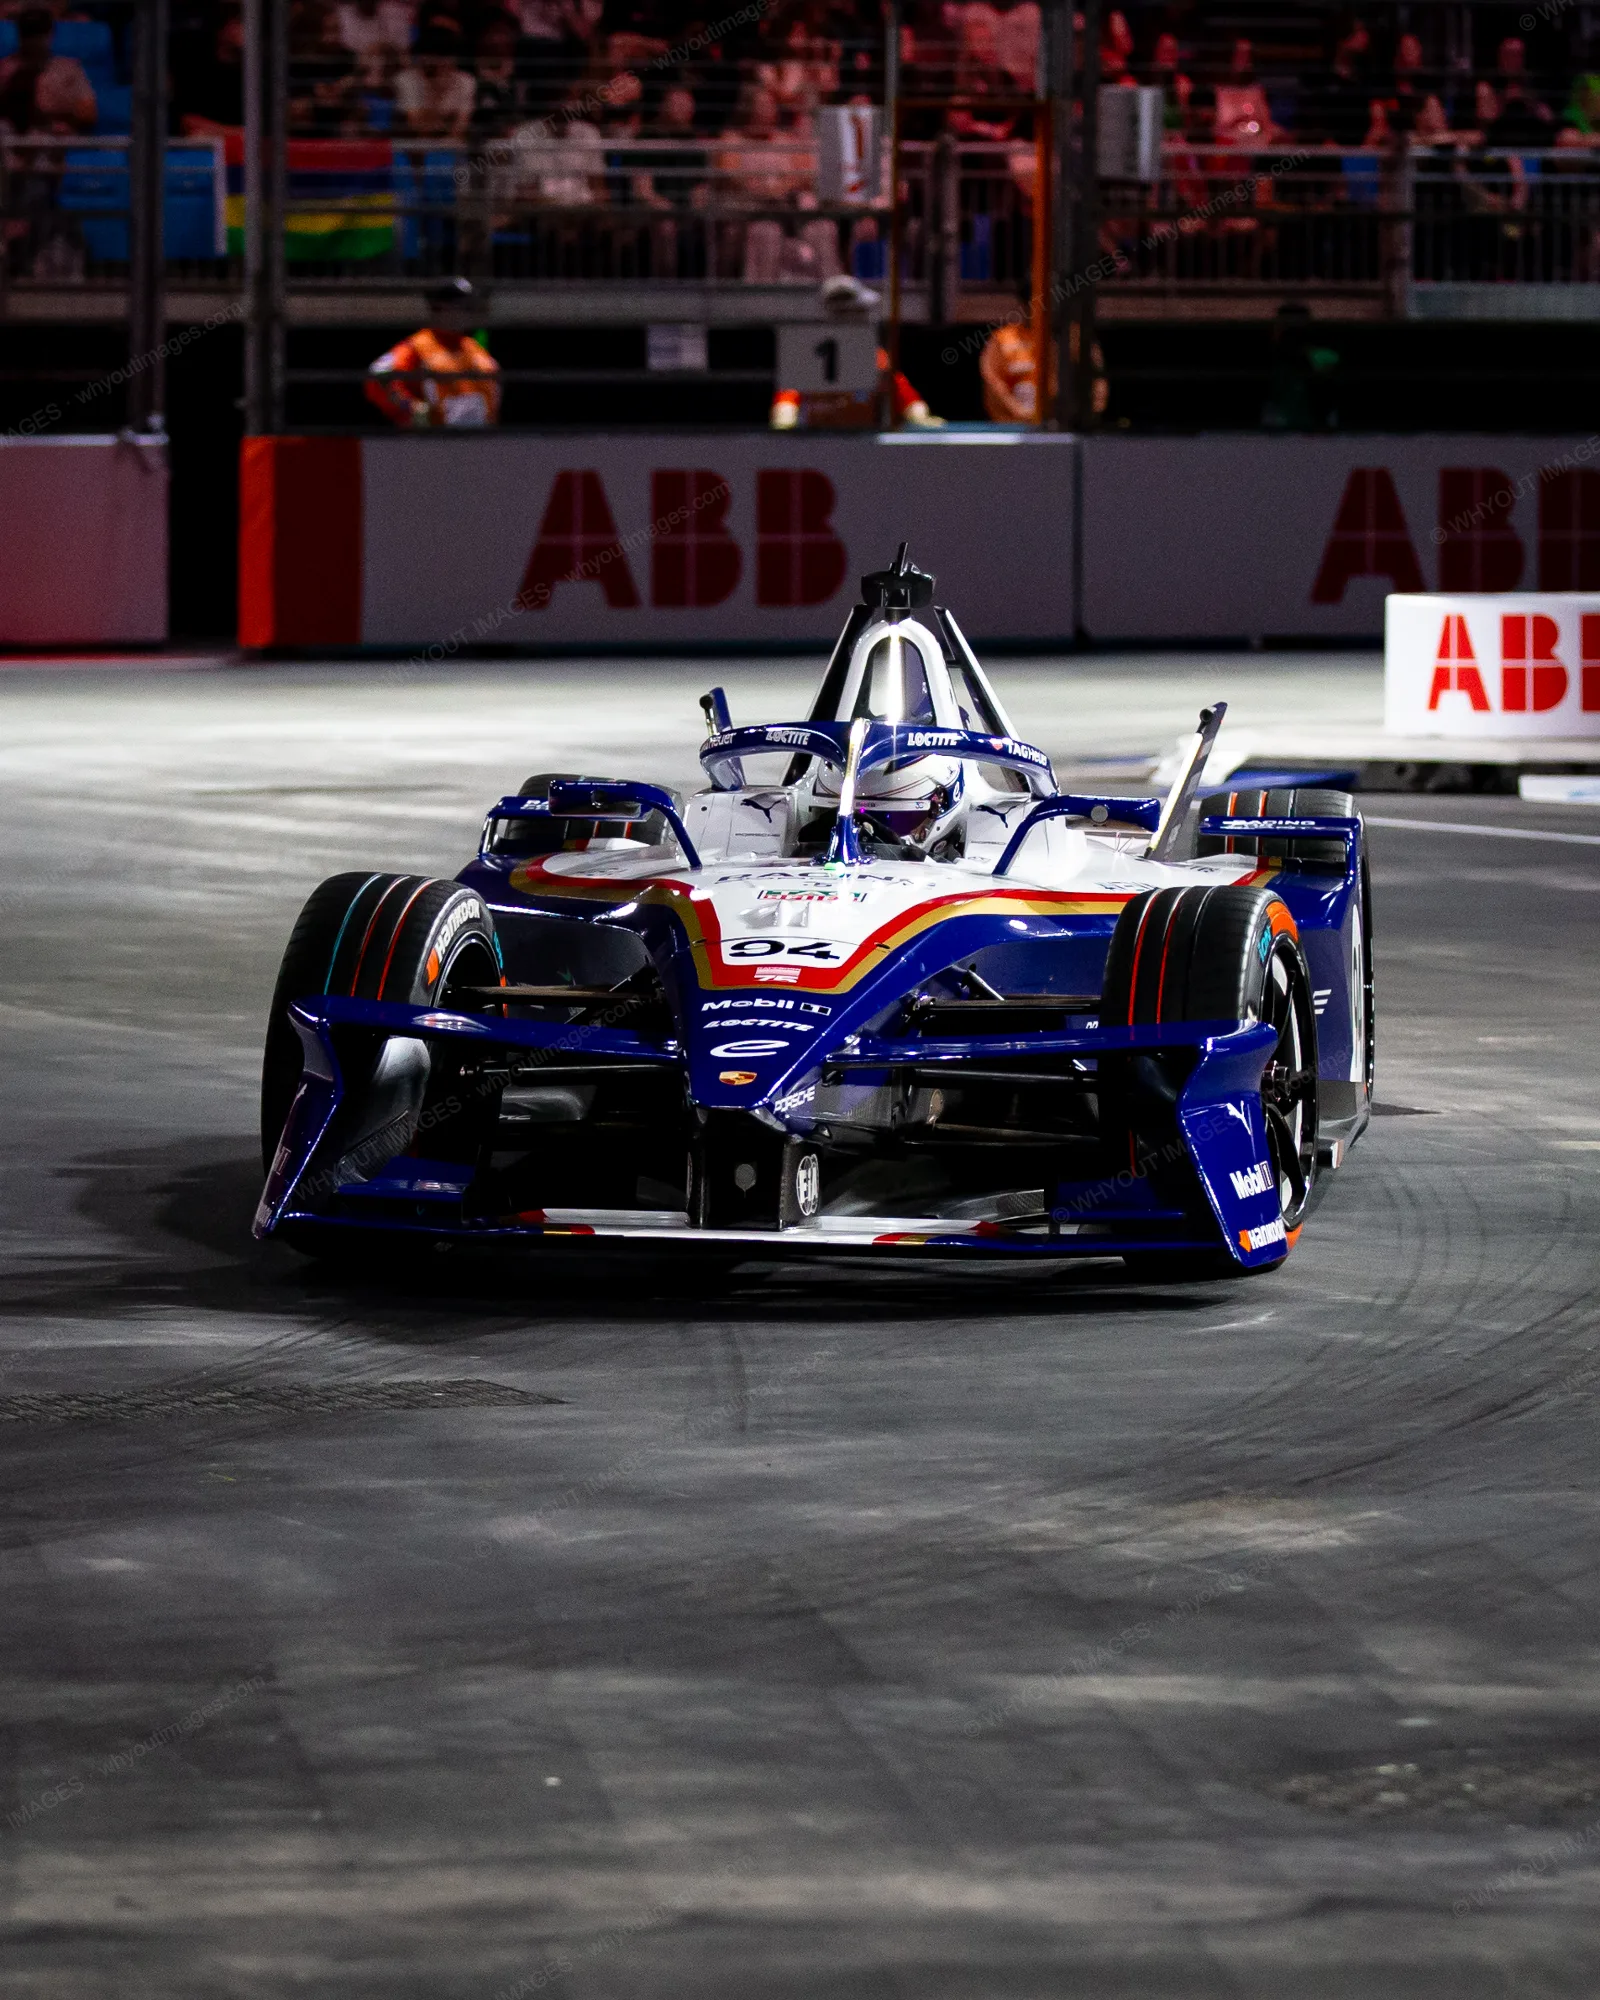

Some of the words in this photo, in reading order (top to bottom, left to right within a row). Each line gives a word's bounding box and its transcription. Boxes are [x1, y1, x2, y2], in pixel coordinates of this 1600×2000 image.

[814, 339, 837, 383] 1
[515, 468, 847, 609] ABB
[765, 730, 811, 745] LOCTITE
[907, 732, 958, 746] LOCTITE
[729, 940, 840, 960] 94
[701, 998, 795, 1012] Mobil
[703, 1019, 815, 1032] LOCTITE
[774, 1086, 815, 1113] PORSCHE
[1230, 1164, 1265, 1199] Mobil
